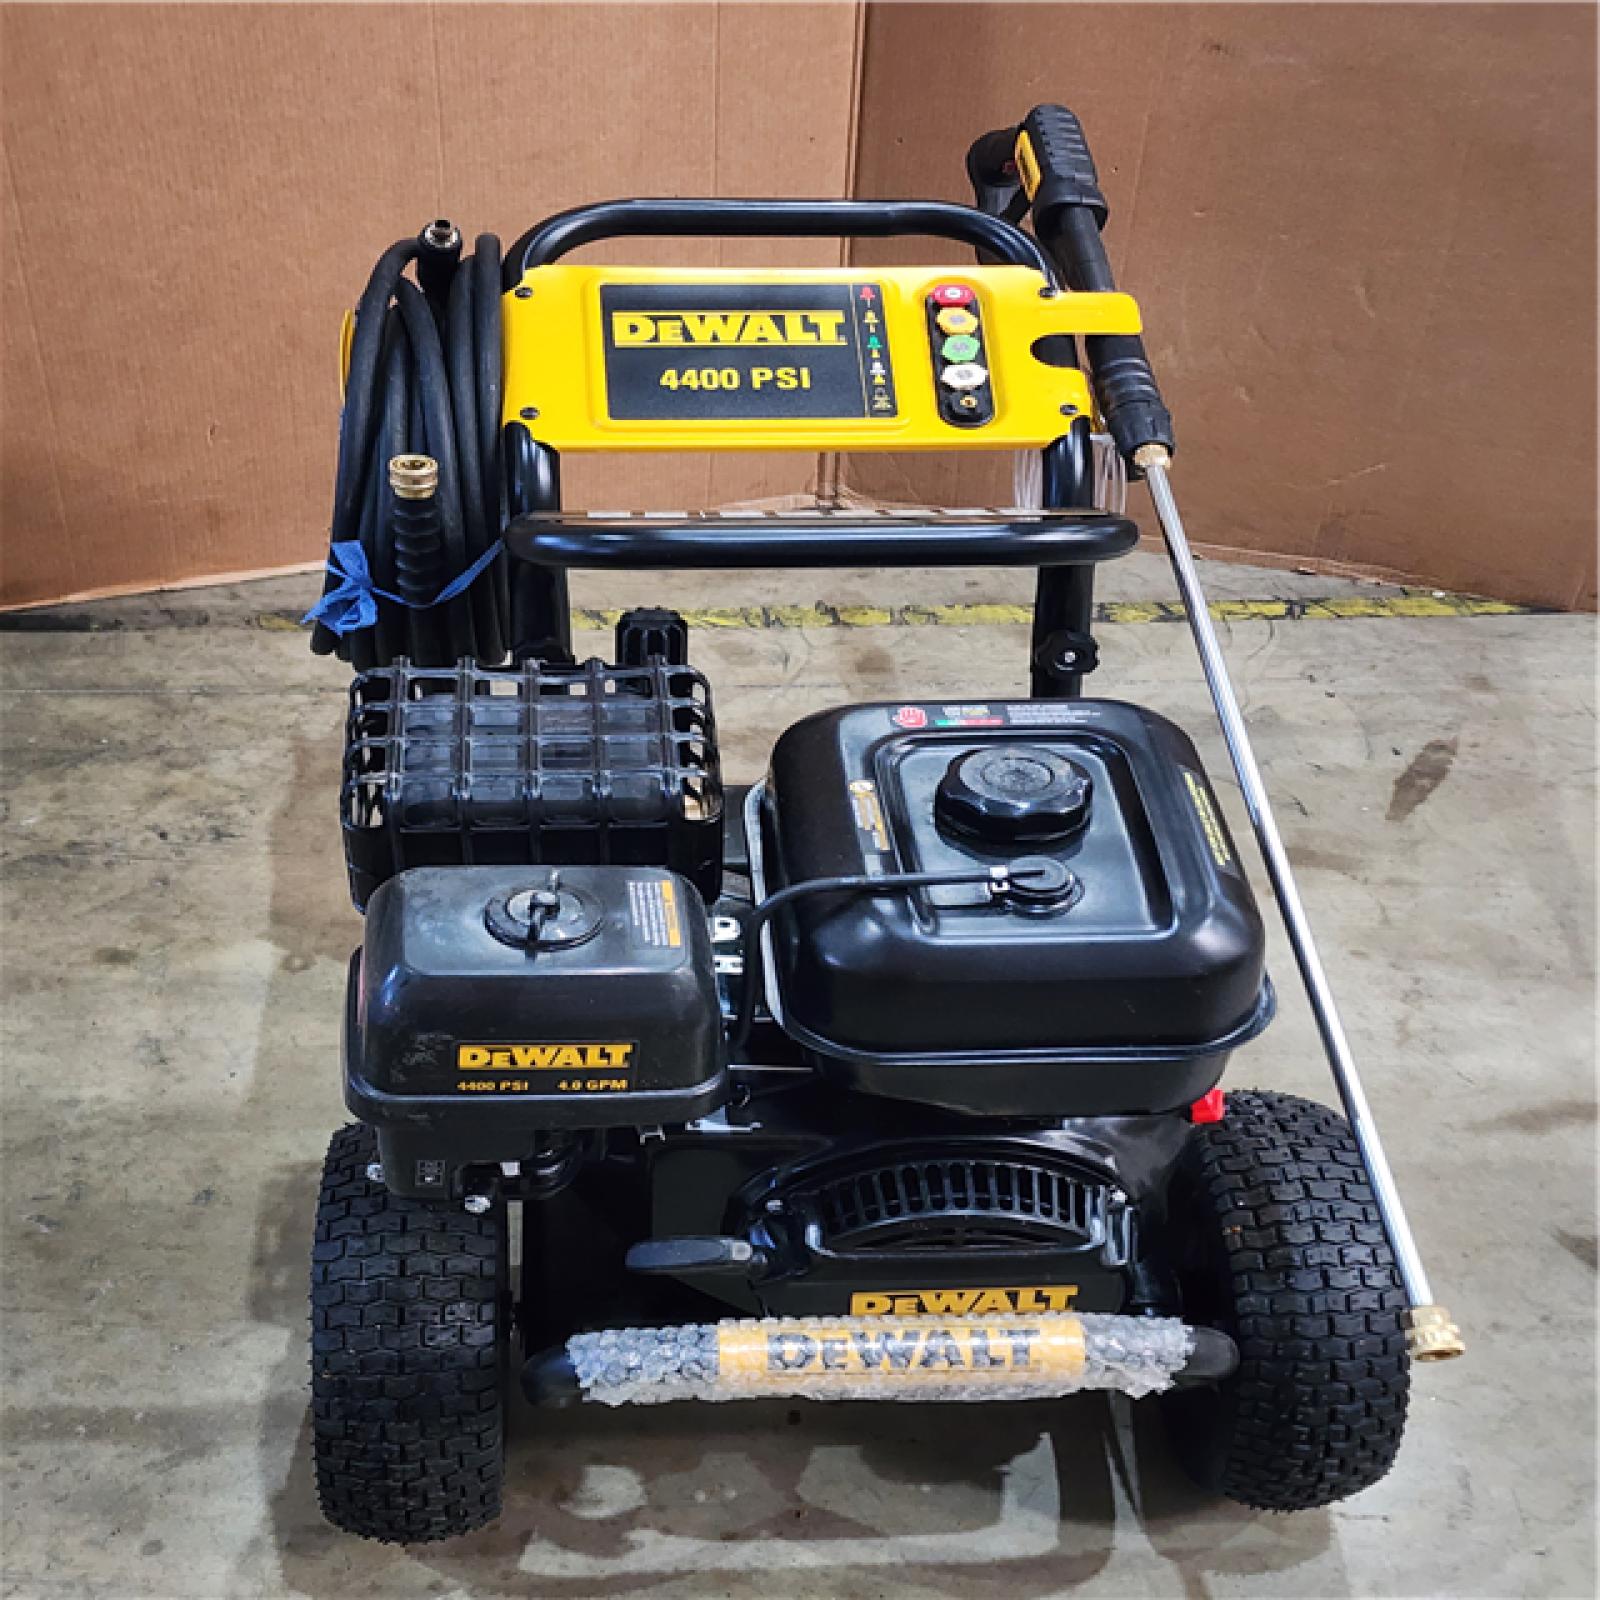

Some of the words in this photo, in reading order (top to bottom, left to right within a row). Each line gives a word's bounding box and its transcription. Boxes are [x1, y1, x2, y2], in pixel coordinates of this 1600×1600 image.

[660, 368, 741, 390] 4400
[751, 367, 811, 389] PSI
[499, 1080, 529, 1090] PSI
[557, 1080, 583, 1090] 4.0
[586, 1080, 628, 1090] GPM
